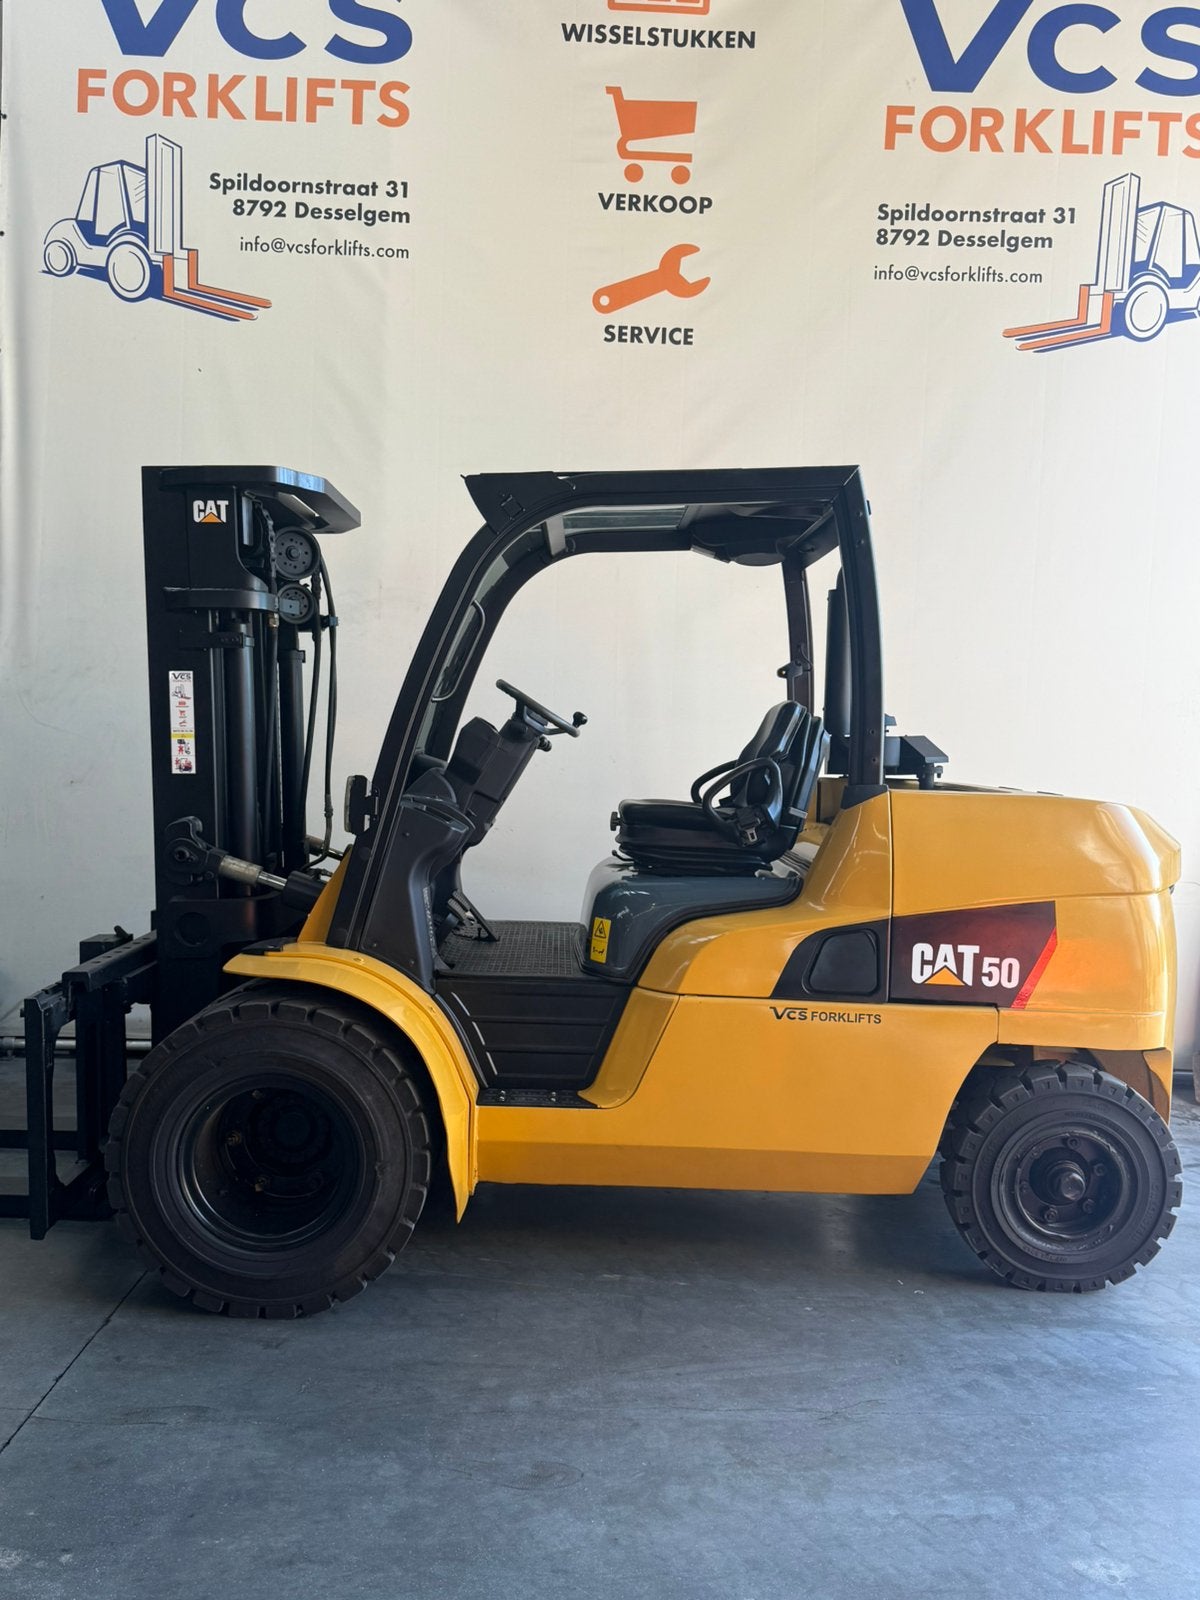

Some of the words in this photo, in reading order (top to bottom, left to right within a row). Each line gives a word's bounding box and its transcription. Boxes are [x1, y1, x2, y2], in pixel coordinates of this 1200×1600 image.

[562, 23, 755, 48] WISSELSTUKKEN
[902, 0, 1200, 96] VCS
[77, 69, 410, 128] FORKLIFTS
[210, 173, 378, 196] Spildoornstraat
[385, 180, 409, 198] 31
[233, 199, 286, 217] 8792
[294, 201, 410, 227] Desselgem
[598, 193, 712, 214] VERKOOP
[878, 203, 1045, 225] Spildoornstraat
[1053, 207, 1076, 224] 31
[241, 236, 408, 258] info@vcsforklifts.com
[876, 229, 929, 245] 8792
[938, 230, 1052, 252] Desselgem
[875, 264, 1042, 282] info@vcsforklifts.com
[604, 325, 693, 345] SERVICE
[193, 501, 228, 522] CAT
[912, 943, 979, 986] CAT
[982, 957, 1020, 988] 50
[769, 1006, 808, 1021] VCS
[811, 1012, 881, 1024] FORKLIFTS
